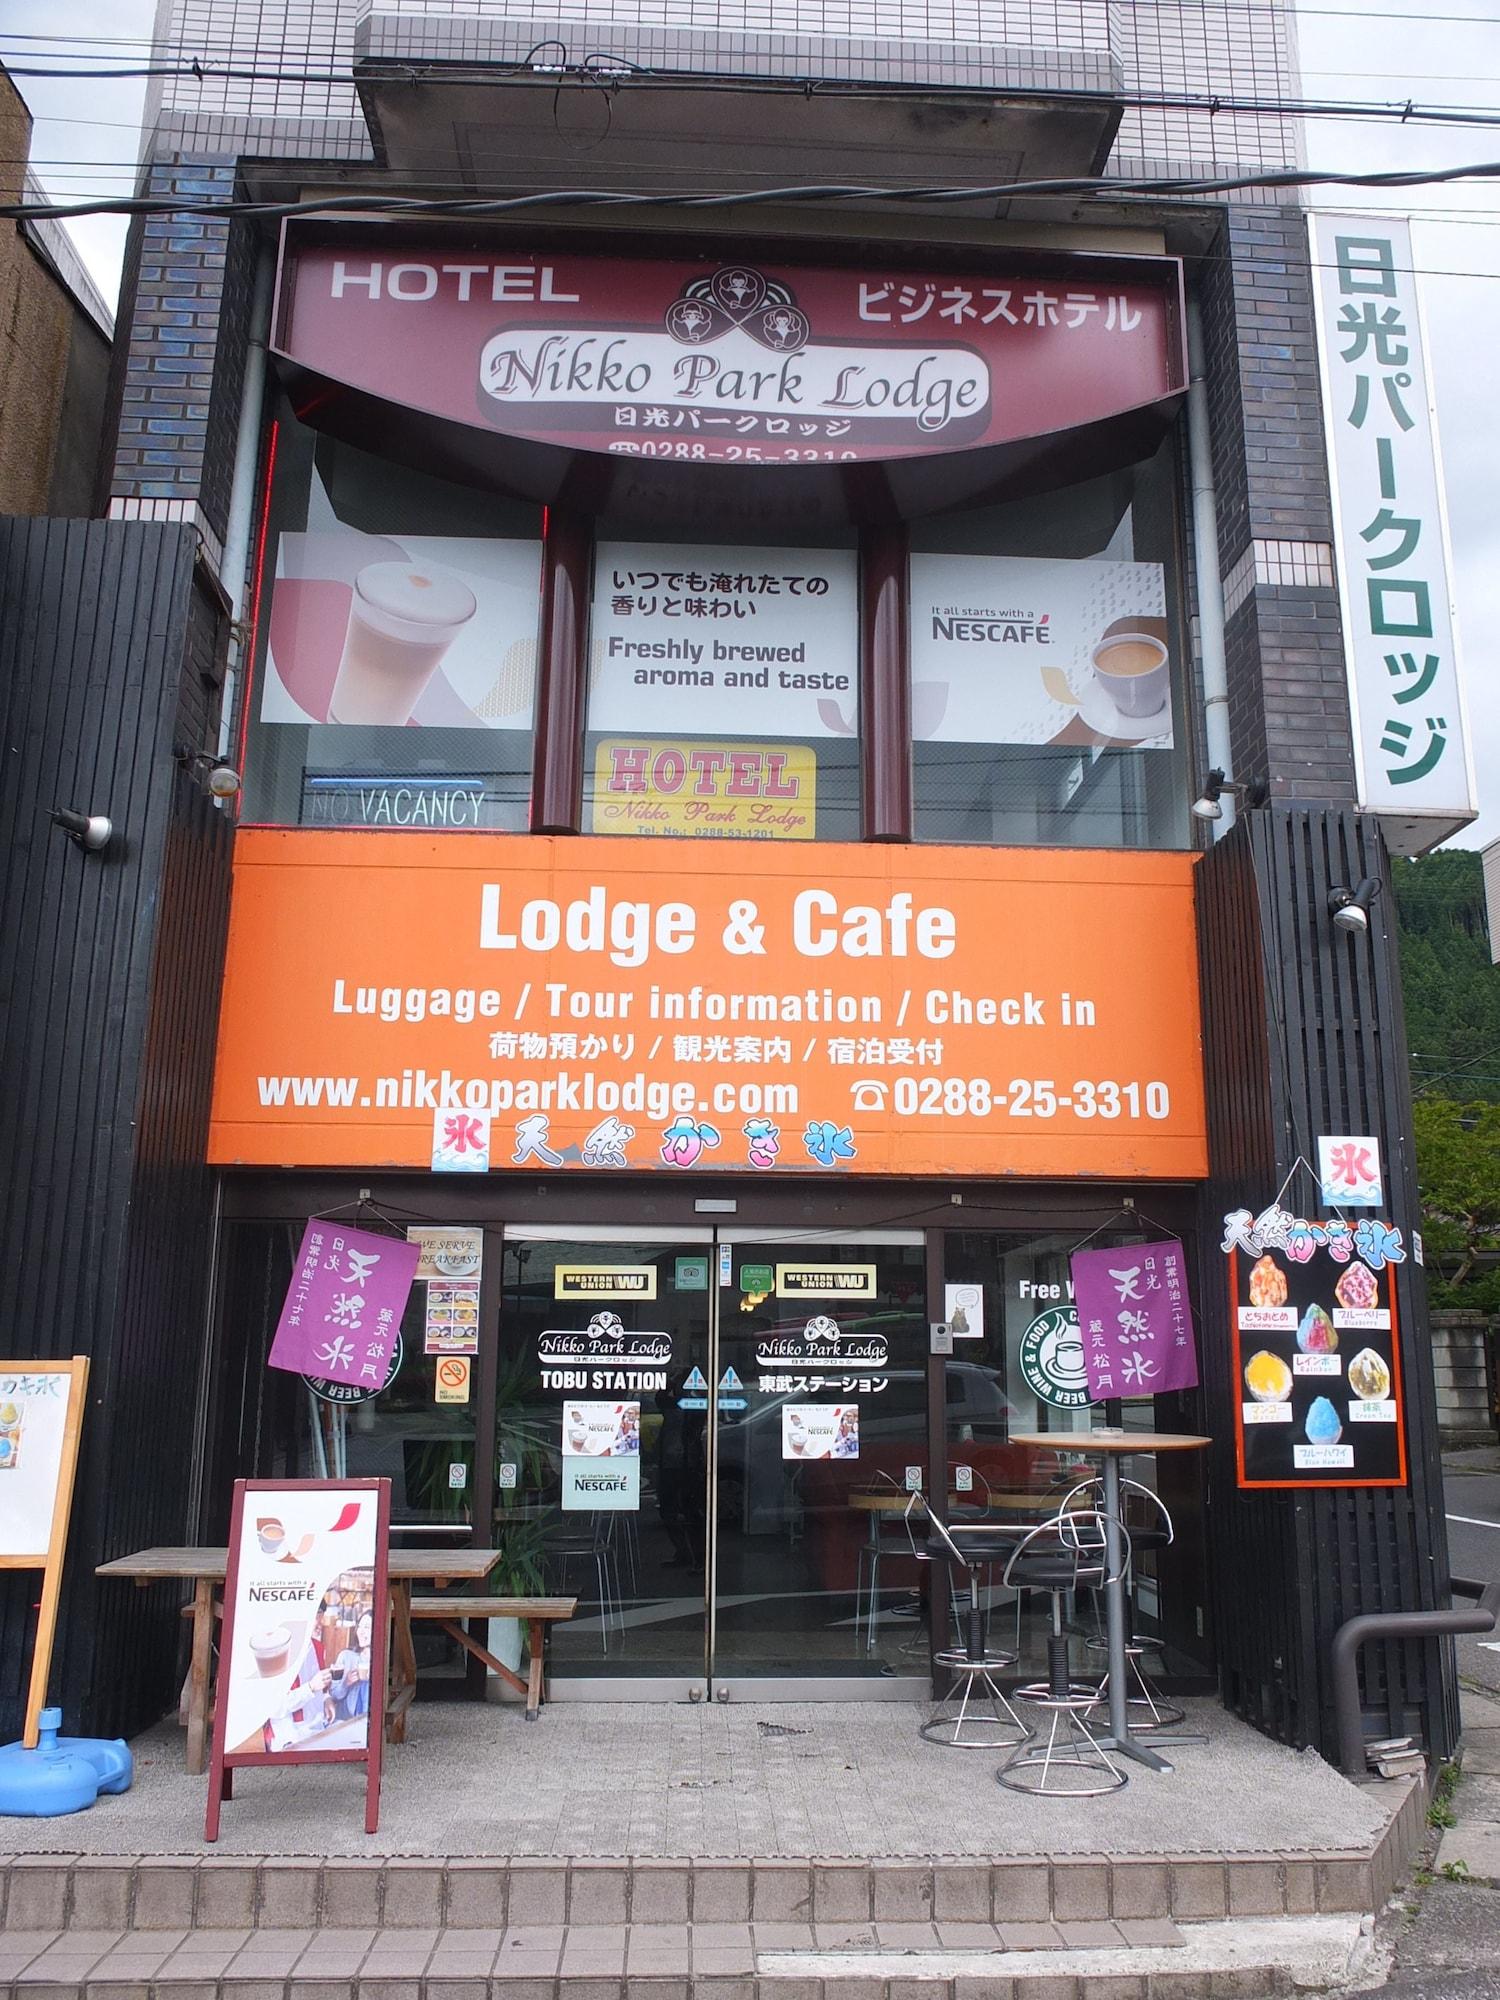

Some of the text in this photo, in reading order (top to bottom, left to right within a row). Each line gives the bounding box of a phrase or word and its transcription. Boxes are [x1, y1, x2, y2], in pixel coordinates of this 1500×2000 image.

[331, 262, 580, 302] HOTEL
[858, 282, 1142, 332] ビジネスホテル
[489, 335, 978, 432] Nikko Park Lodge
[614, 406, 851, 437] 日光パークロッジ
[1334, 236, 1447, 785] 日光パークロッジ
[612, 571, 829, 596] いつでも淹れたての
[611, 595, 756, 618] 香りと味わい
[932, 606, 1034, 619] It all starts with a
[608, 636, 805, 665] Freshly brewed
[634, 667, 850, 690] aroma and taste
[607, 748, 799, 799] HOTEL
[311, 788, 485, 826] NO VACANCY
[604, 800, 806, 831] Nikko Park Lodge
[637, 826, 657, 836] Tel.
[479, 883, 956, 967] Lodge & Cafe
[333, 979, 1096, 1026] Luggage / Tour information / Check in
[489, 1032, 636, 1061] 荷物預かり
[673, 1034, 792, 1064] 観光案内
[827, 1038, 944, 1066] 宿泊受付
[257, 1070, 1170, 1120] www.nikkoparklodge.com 0288-25-3310
[444, 1114, 484, 1153] 氷
[512, 1114, 856, 1168] 天然かき氷
[1330, 1143, 1378, 1186] 氷
[438, 1240, 476, 1250] SERVE
[1221, 1204, 1407, 1270] 天然かき氷
[566, 1275, 613, 1283] WESTERN
[614, 1275, 644, 1289] WU
[787, 1274, 833, 1282] WESTERN
[801, 1280, 833, 1288] UNION
[834, 1274, 864, 1288] WU
[1144, 1256, 1162, 1291] 日光
[1019, 1280, 1061, 1299] Free
[1164, 1255, 1187, 1347] 創業明治二十七年
[1108, 1266, 1162, 1386] 天然氷
[1245, 1311, 1289, 1322] とちおとめ
[541, 1336, 670, 1360] Nikko Park Lodge
[758, 1338, 886, 1362] Nikko Park Lodge
[1025, 1320, 1087, 1405] BEER WINE & FOOD
[328, 1384, 361, 1399] BEER
[540, 1370, 667, 1390] TOBU STATION
[758, 1375, 888, 1393] 東武ステーション
